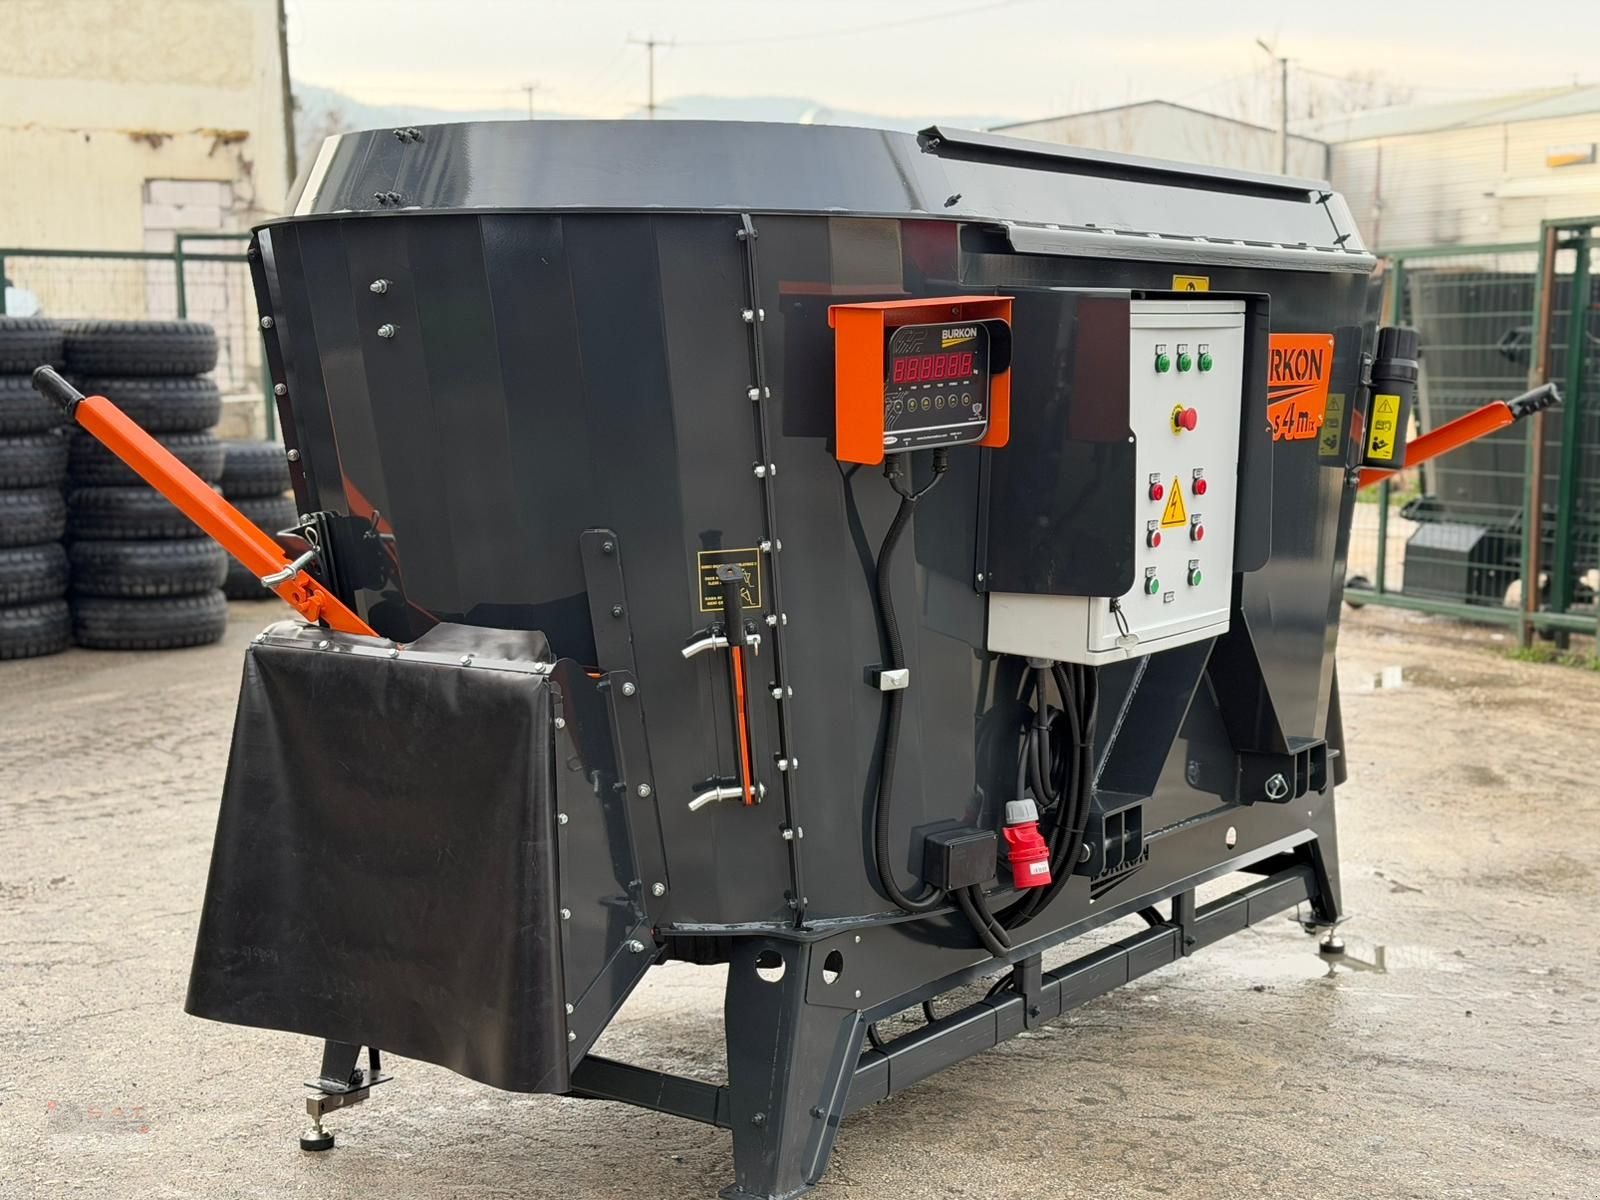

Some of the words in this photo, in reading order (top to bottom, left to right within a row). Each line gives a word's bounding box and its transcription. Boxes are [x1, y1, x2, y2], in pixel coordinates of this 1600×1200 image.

[942, 327, 977, 339] BURKON
[1269, 348, 1323, 381] RKON
[1282, 402, 1295, 434] 4
